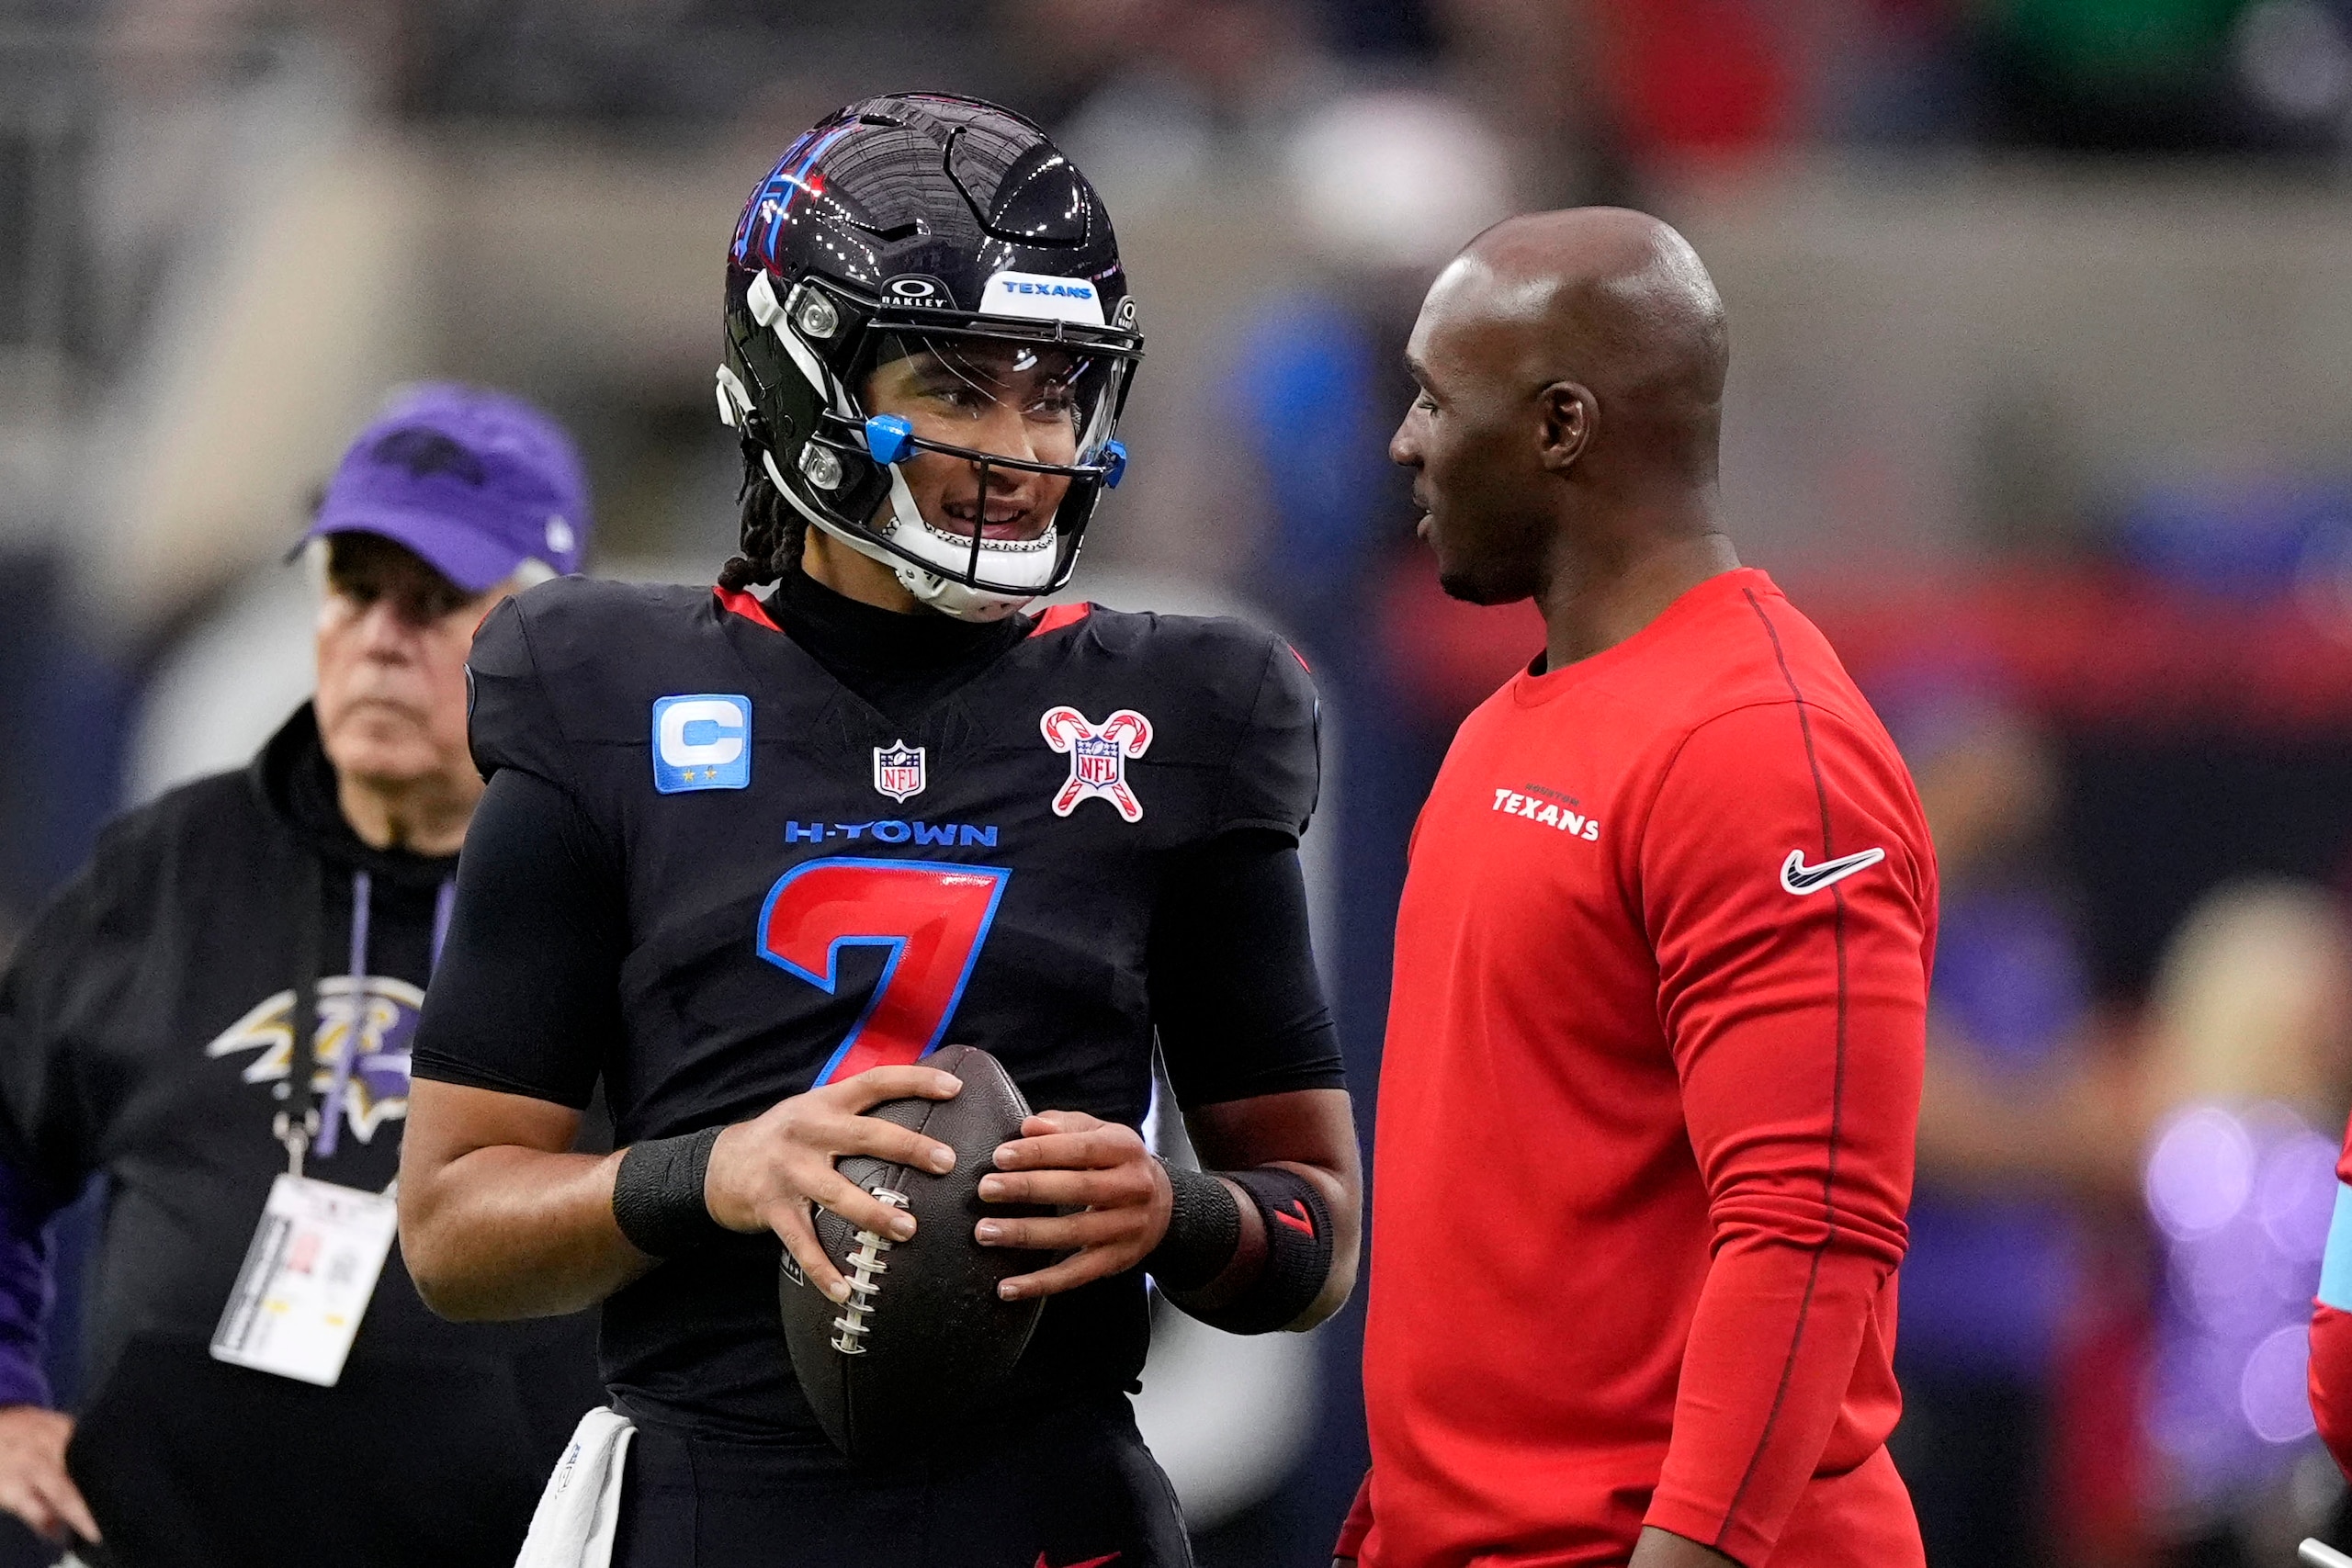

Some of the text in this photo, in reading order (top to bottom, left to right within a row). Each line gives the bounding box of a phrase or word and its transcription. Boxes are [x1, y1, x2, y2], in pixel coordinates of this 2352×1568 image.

[881, 295, 944, 308] OAKLEY
[1002, 281, 1092, 299] TEXANS
[661, 701, 743, 767] C
[884, 769, 917, 790] NFL
[1080, 757, 1114, 782] NFL
[1492, 788, 1600, 841] TEXANS
[786, 820, 997, 847] H-TOWN
[757, 857, 1011, 1089] 7
